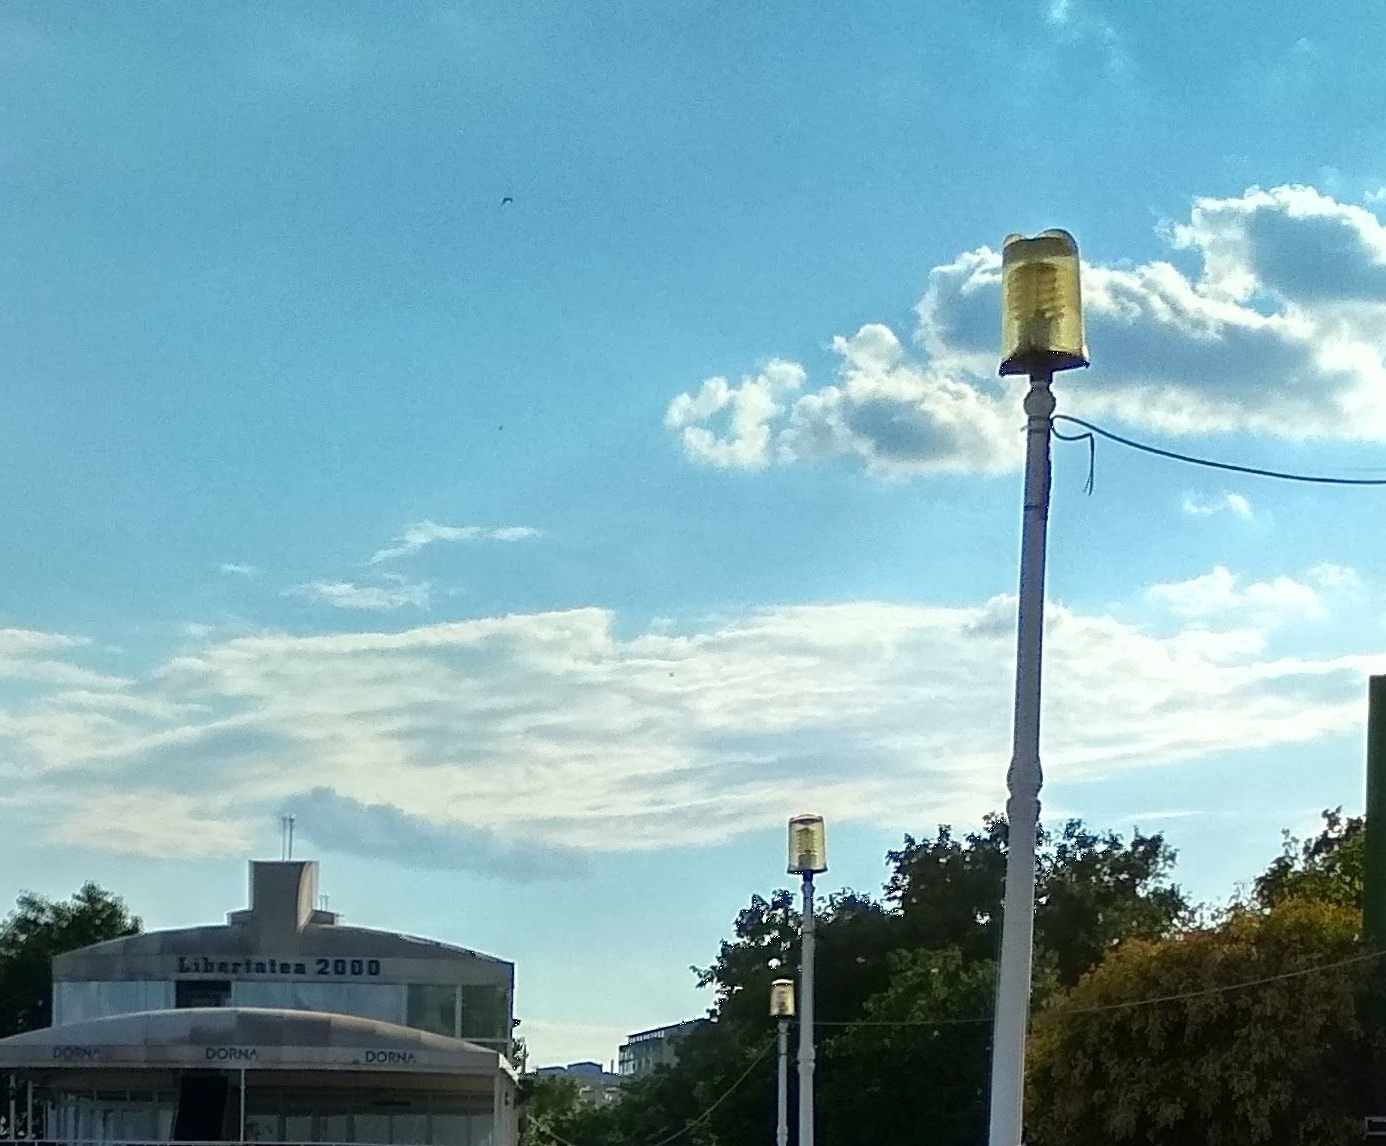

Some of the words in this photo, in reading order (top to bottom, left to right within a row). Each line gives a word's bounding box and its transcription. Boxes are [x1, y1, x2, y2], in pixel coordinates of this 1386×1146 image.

[178, 956, 307, 974] Libertatea
[316, 958, 381, 976] 2000
[205, 1047, 258, 1060] DORNA
[365, 1050, 417, 1064] DORNA
